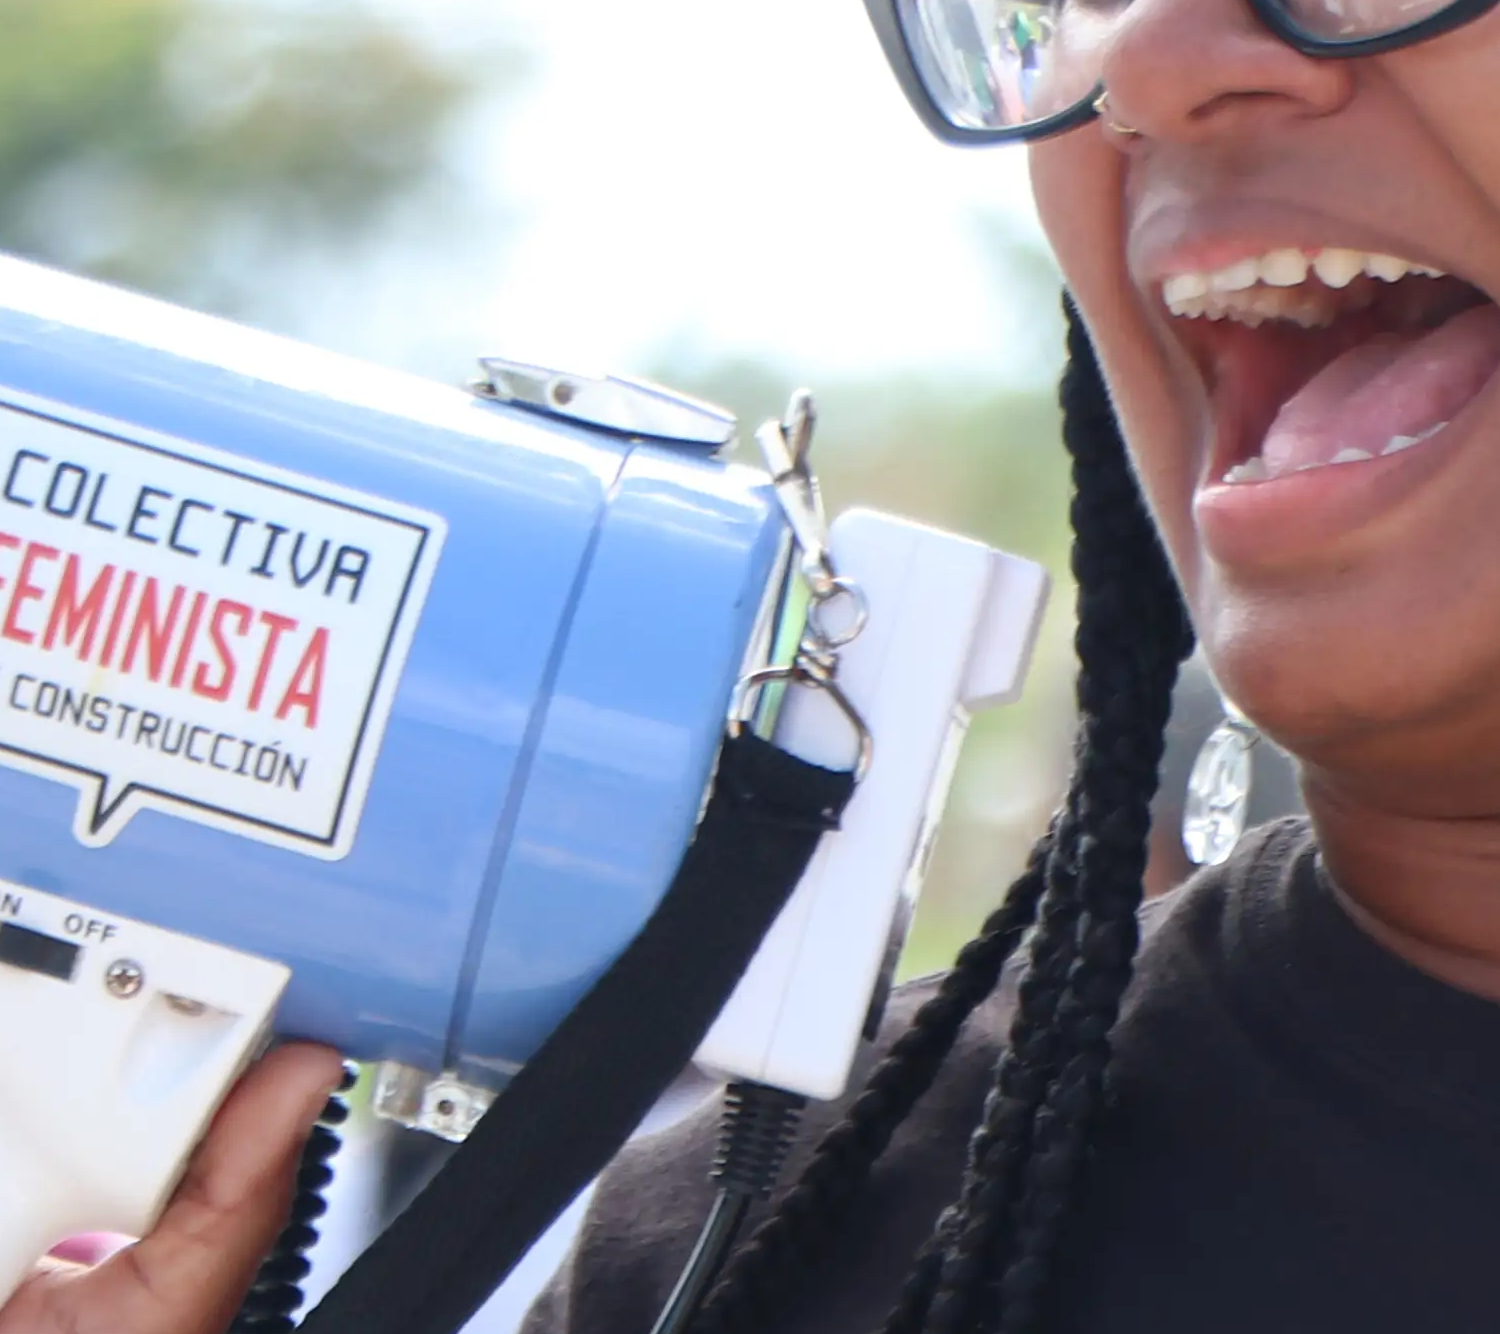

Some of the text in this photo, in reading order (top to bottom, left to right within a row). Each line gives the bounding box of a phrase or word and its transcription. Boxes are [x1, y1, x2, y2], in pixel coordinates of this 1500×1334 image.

[2, 448, 372, 605] COLECTIVA
[8, 673, 310, 792] CONSTRUCCIÓN
[64, 913, 119, 943] OFF
